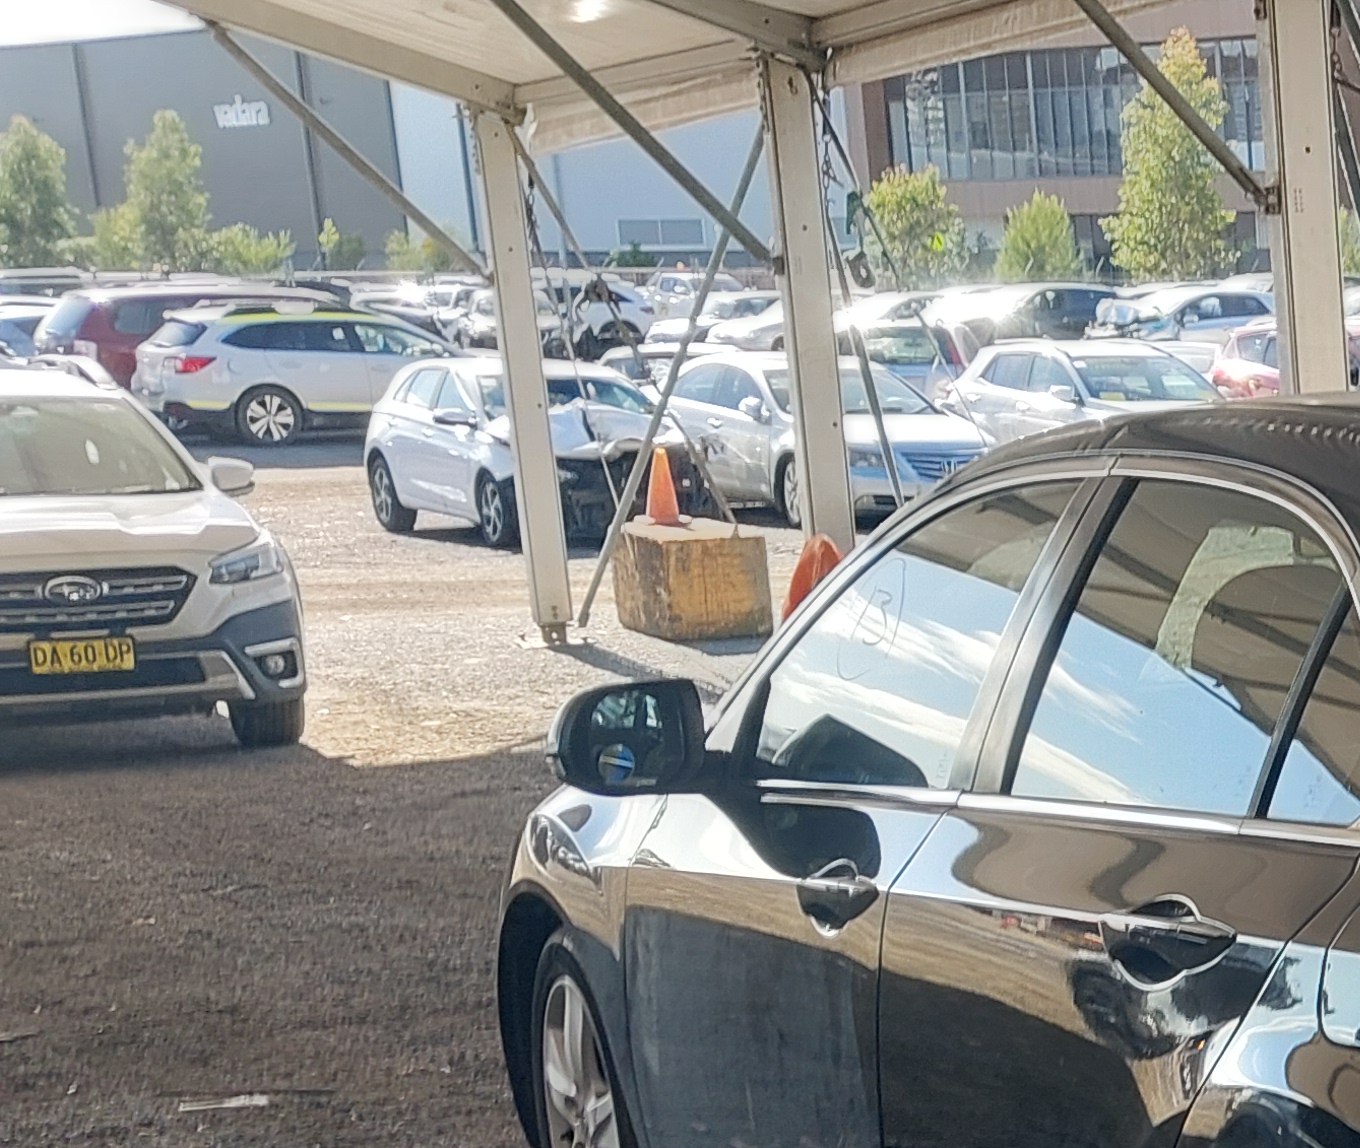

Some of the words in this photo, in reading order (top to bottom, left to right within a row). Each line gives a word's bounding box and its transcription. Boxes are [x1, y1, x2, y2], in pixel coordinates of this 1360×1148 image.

[33, 645, 62, 667] DA
[69, 643, 97, 665] 60
[104, 639, 131, 663] DP
